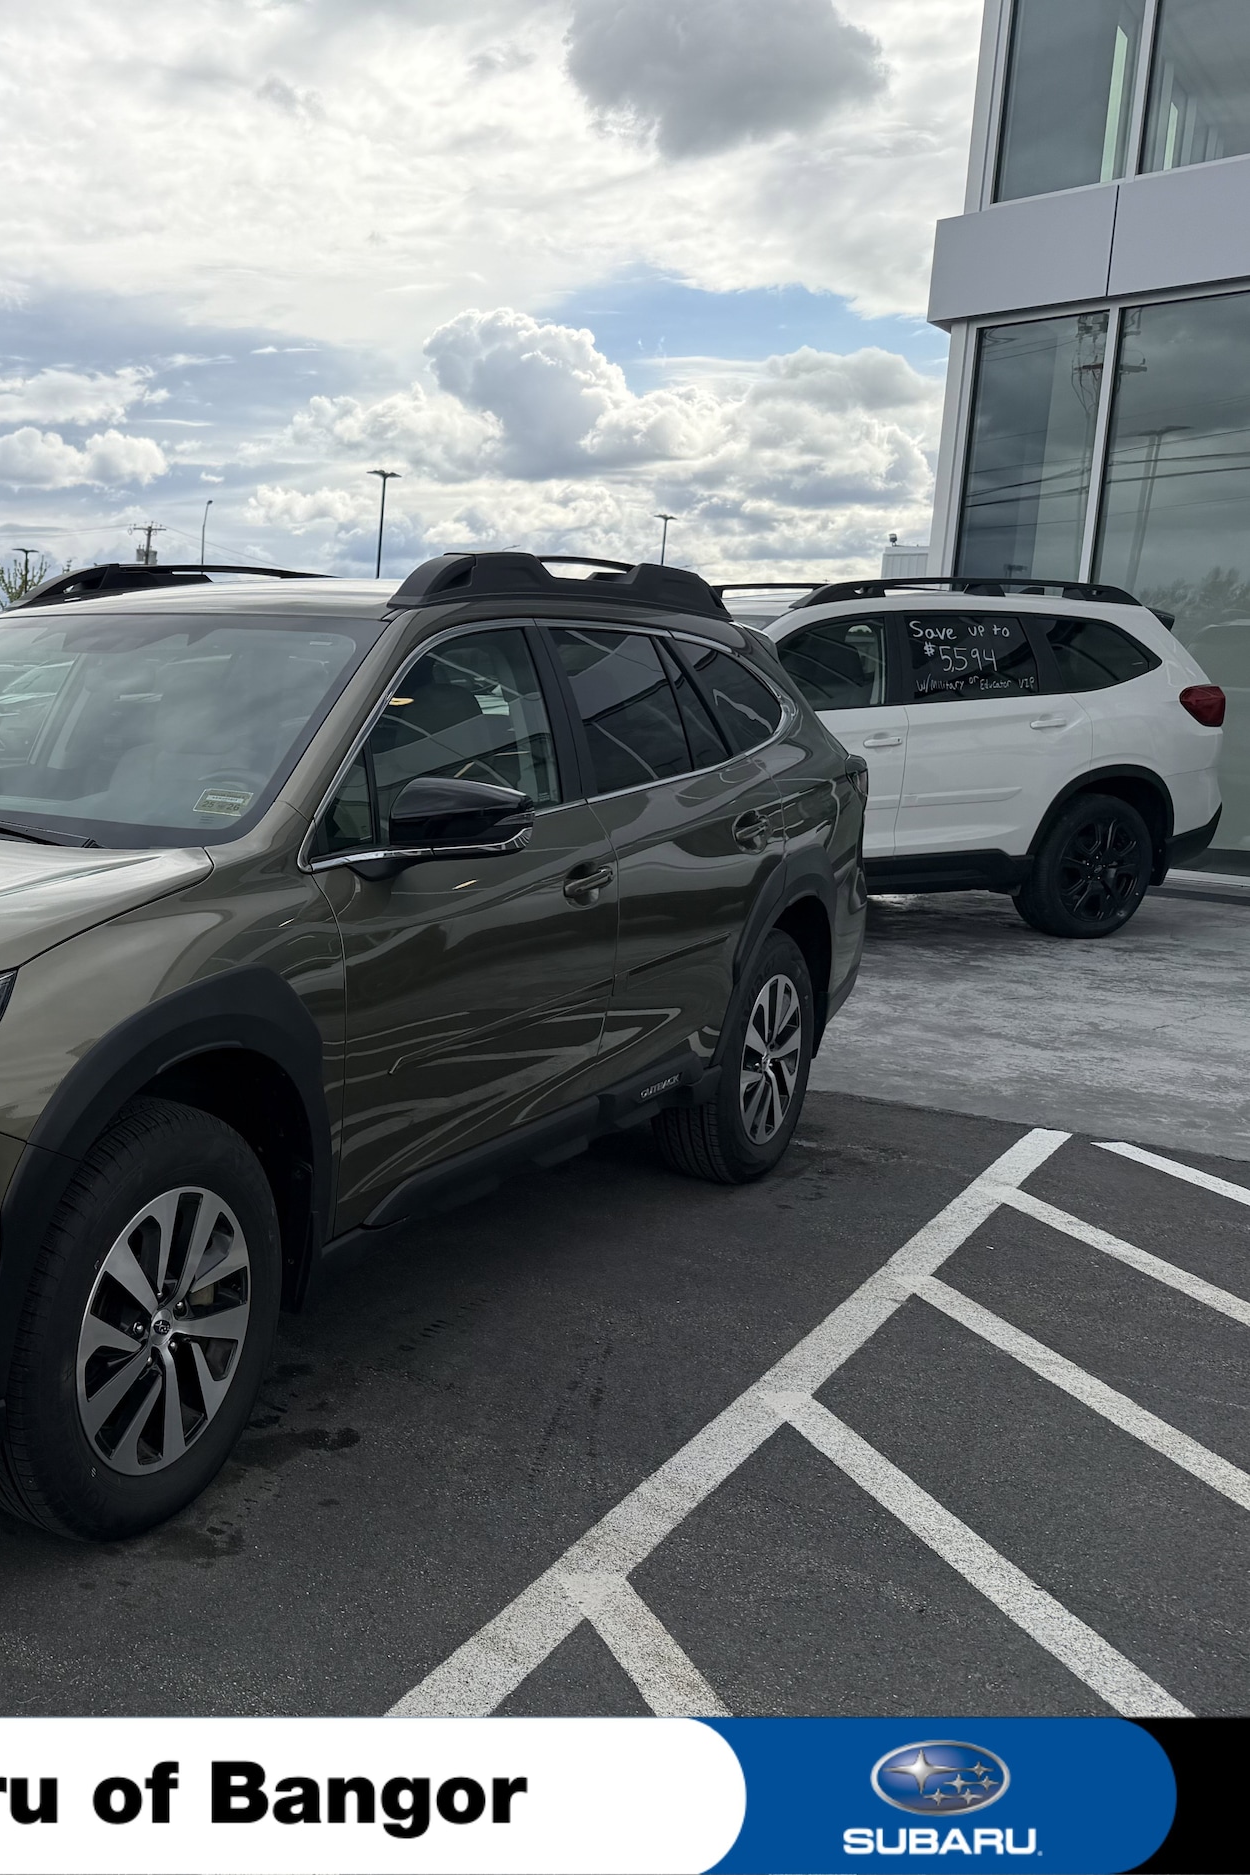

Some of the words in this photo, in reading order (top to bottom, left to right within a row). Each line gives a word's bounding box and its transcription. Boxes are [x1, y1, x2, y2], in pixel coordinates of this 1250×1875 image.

[909, 620, 957, 640] Save
[992, 624, 1010, 637] to
[923, 641, 997, 672] $5,594
[969, 675, 979, 684] or
[980, 679, 1011, 690] Educator
[1018, 676, 1034, 689] VIP
